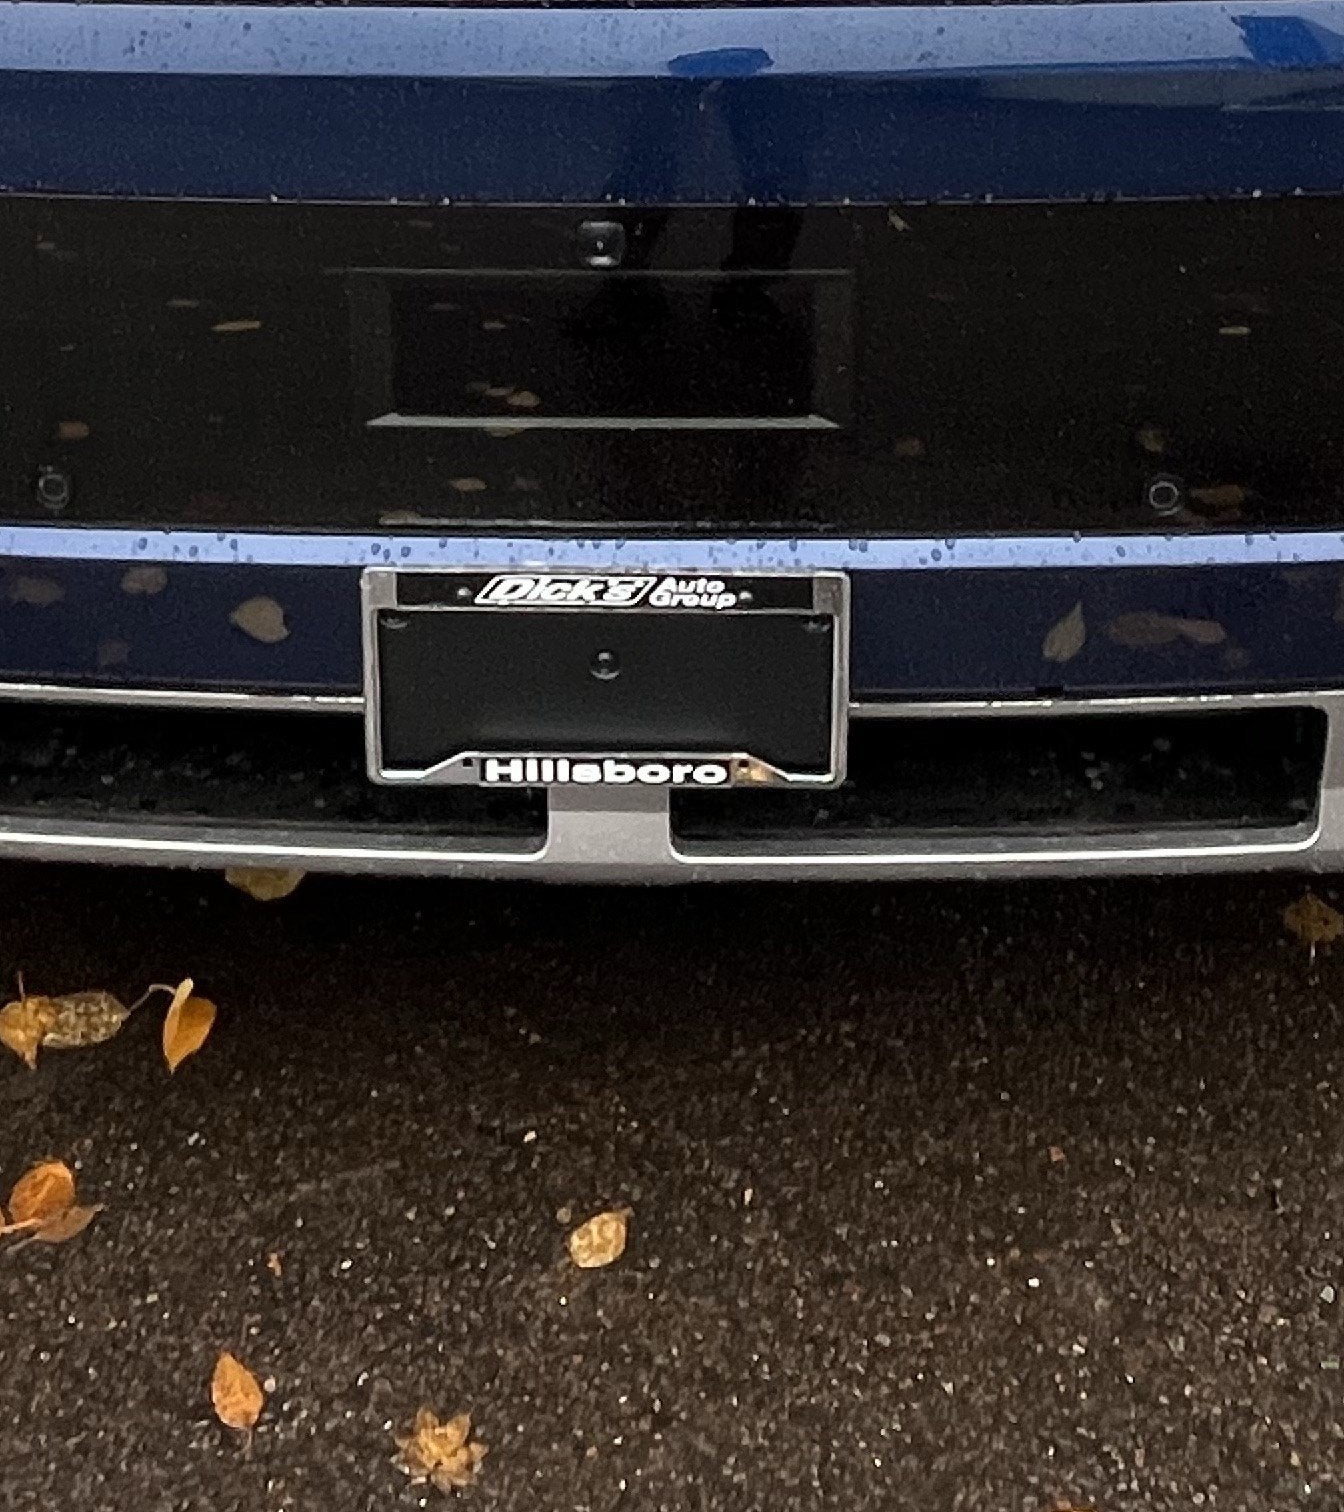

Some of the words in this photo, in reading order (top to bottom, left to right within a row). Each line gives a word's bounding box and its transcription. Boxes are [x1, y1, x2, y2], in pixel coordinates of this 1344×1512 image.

[655, 576, 726, 595] Auto
[648, 590, 737, 610] Group
[485, 758, 729, 785] Hillsboro
